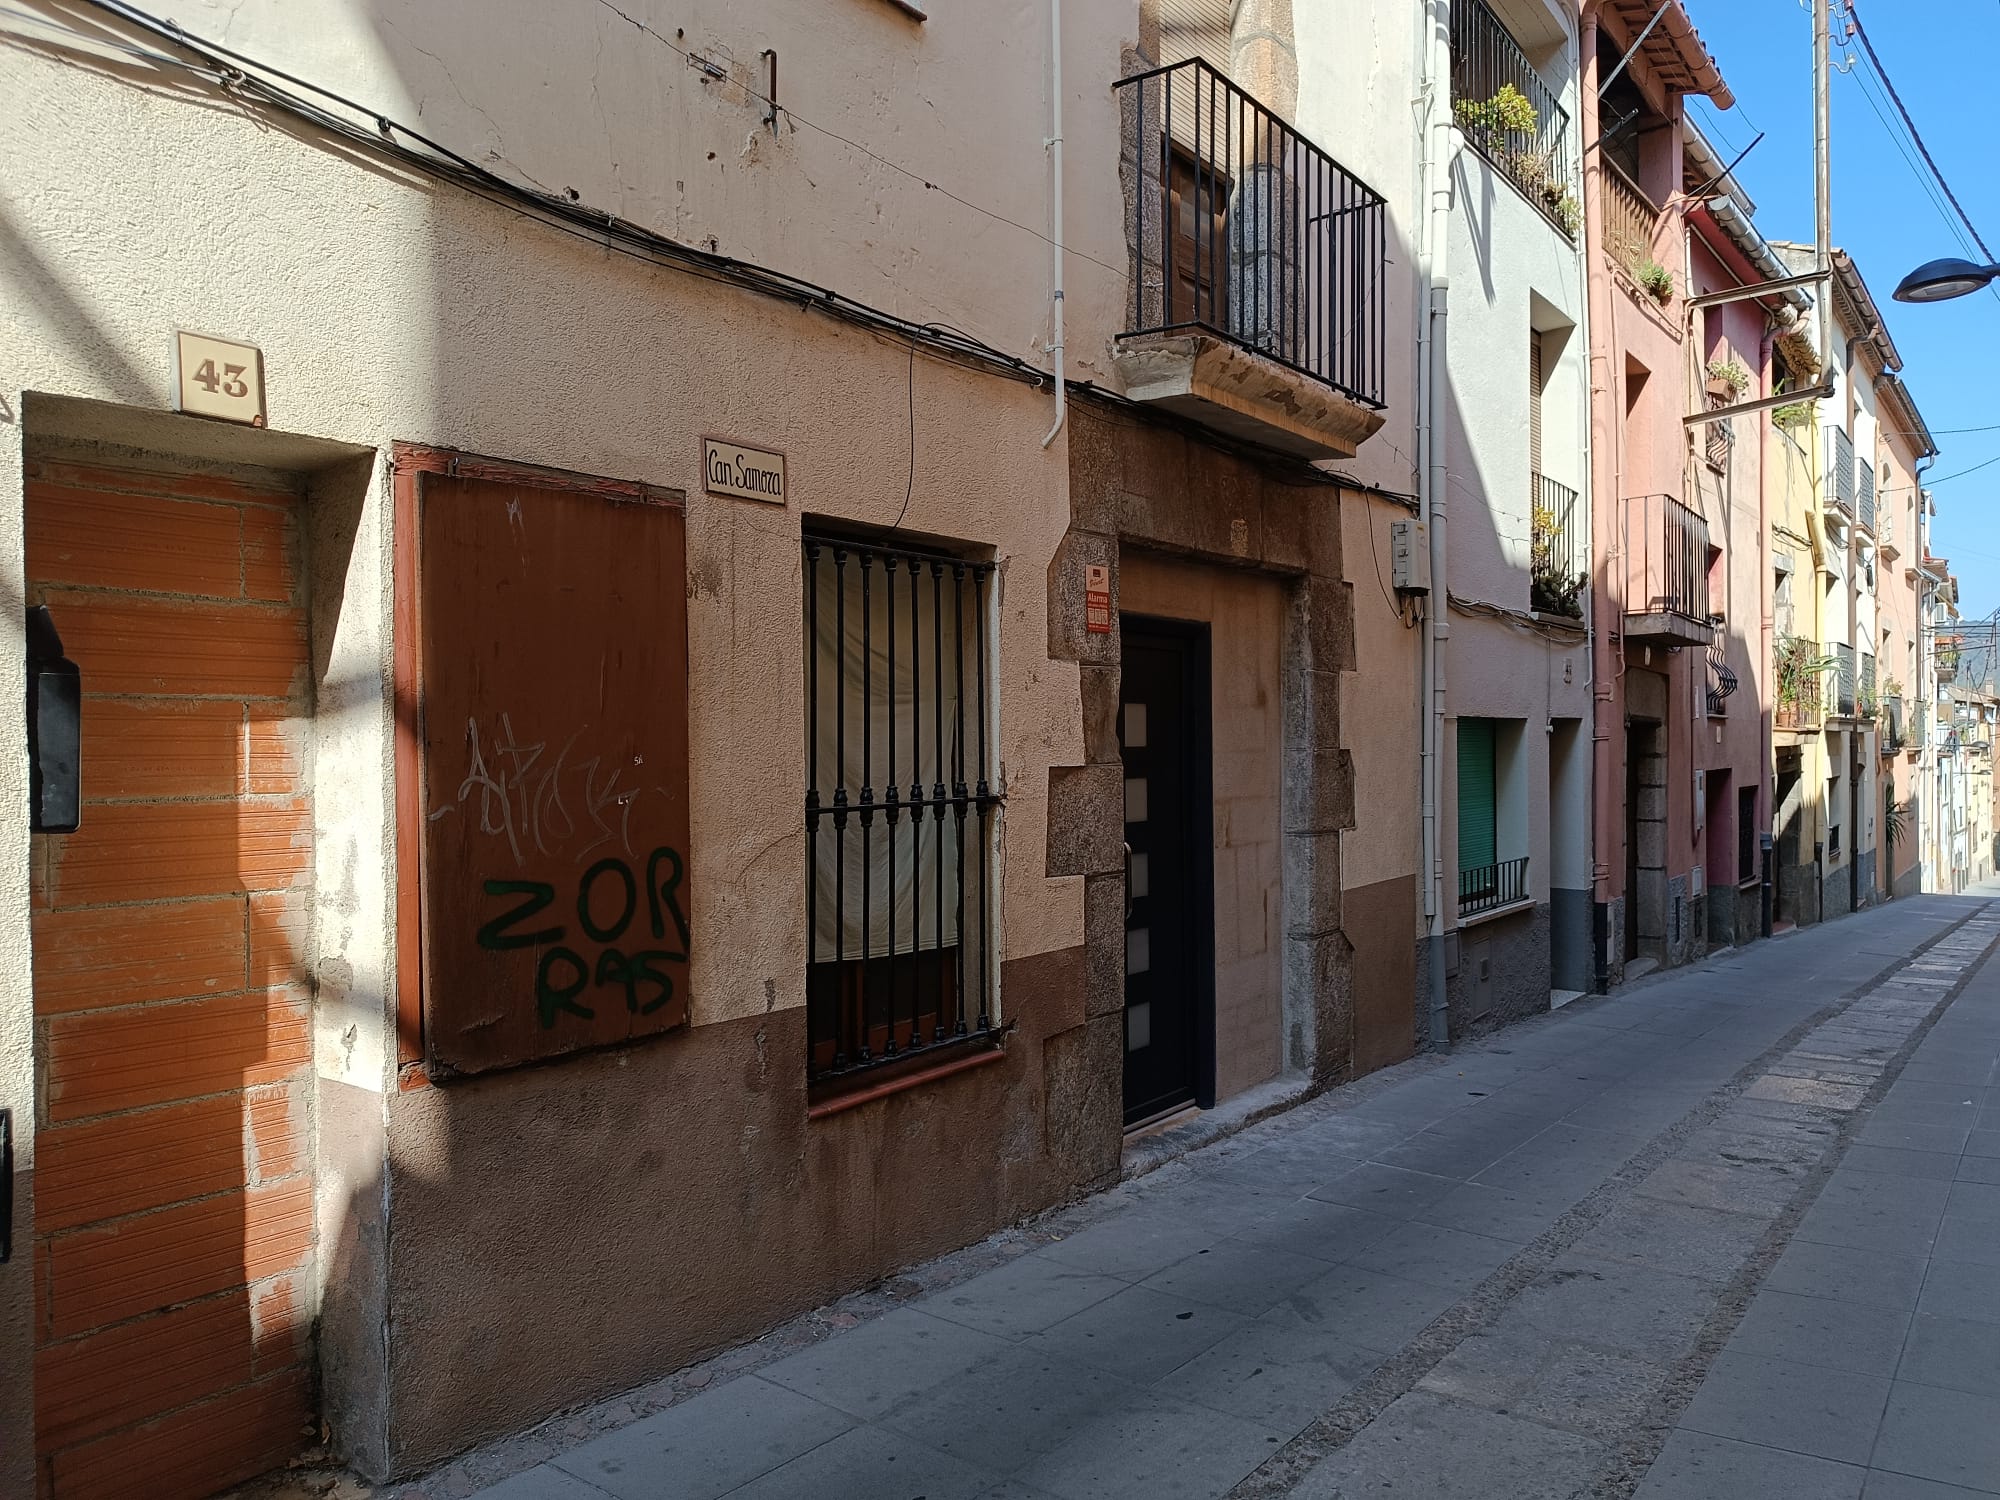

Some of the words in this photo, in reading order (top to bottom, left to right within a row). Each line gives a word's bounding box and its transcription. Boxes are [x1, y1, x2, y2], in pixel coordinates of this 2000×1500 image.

[192, 358, 248, 397] 43
[708, 448, 734, 487] Can
[735, 453, 782, 496] Samora
[1088, 592, 1108, 604] Alarma
[477, 846, 690, 951] ZOR
[537, 946, 688, 1030] RAS
